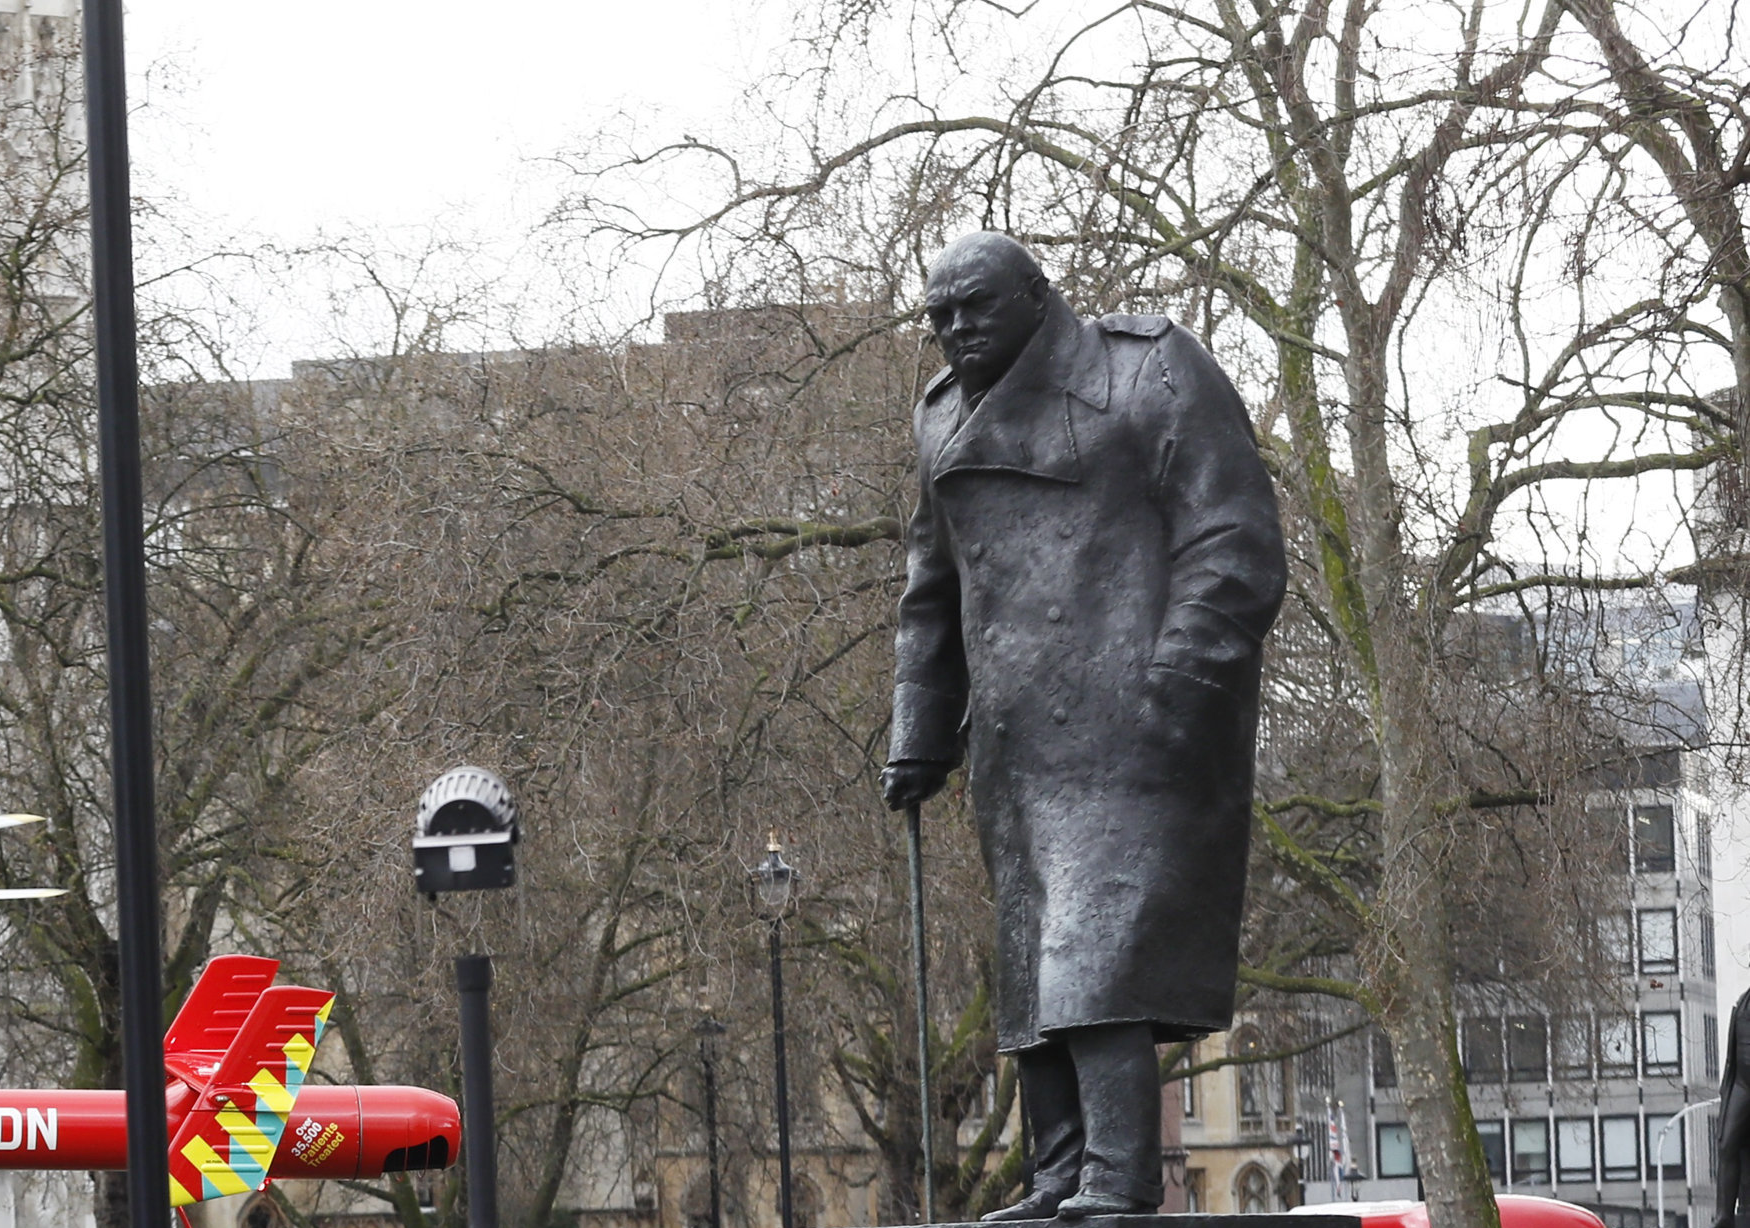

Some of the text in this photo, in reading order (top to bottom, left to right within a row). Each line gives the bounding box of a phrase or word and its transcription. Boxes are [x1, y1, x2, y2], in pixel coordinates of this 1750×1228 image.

[291, 1122, 323, 1157] 35,500
[295, 1117, 313, 1136] Over
[299, 1122, 339, 1163] Patients
[307, 1131, 345, 1168] Treated
